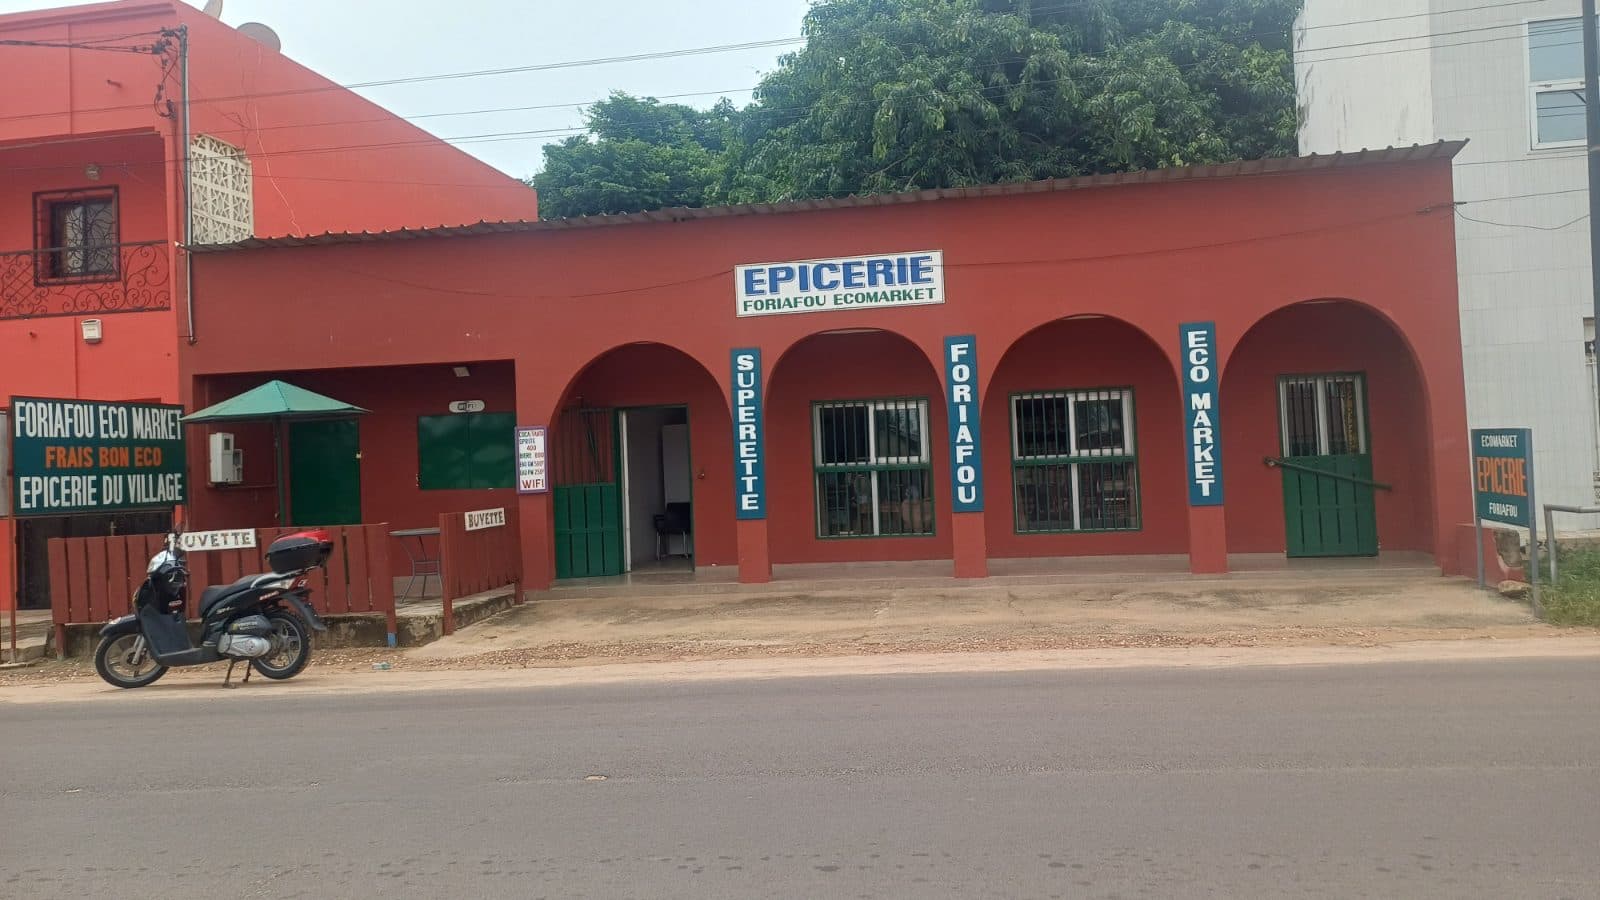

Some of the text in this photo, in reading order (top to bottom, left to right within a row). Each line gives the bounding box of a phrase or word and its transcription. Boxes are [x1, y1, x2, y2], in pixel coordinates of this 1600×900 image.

[744, 255, 934, 296] EPICERIE
[743, 287, 936, 312] FORIAFOU ECOMARKET
[15, 402, 182, 440] FORIAFOU ECO MARKET
[950, 343, 976, 503] FORIAFOU
[1187, 330, 1215, 497] ECO MARKET
[737, 354, 759, 510] SUPERETTE
[1481, 435, 1518, 447] ECOMARKET
[45, 446, 162, 469] FRAIS BON ECO
[19, 473, 182, 509] EPICERIE DU VILLAGE
[522, 479, 544, 489] WIFI
[1476, 456, 1527, 496] EPICERIE
[468, 511, 504, 528] BUVETTE
[1489, 502, 1518, 517] FORIAFOU
[182, 531, 251, 548] UVETTE
